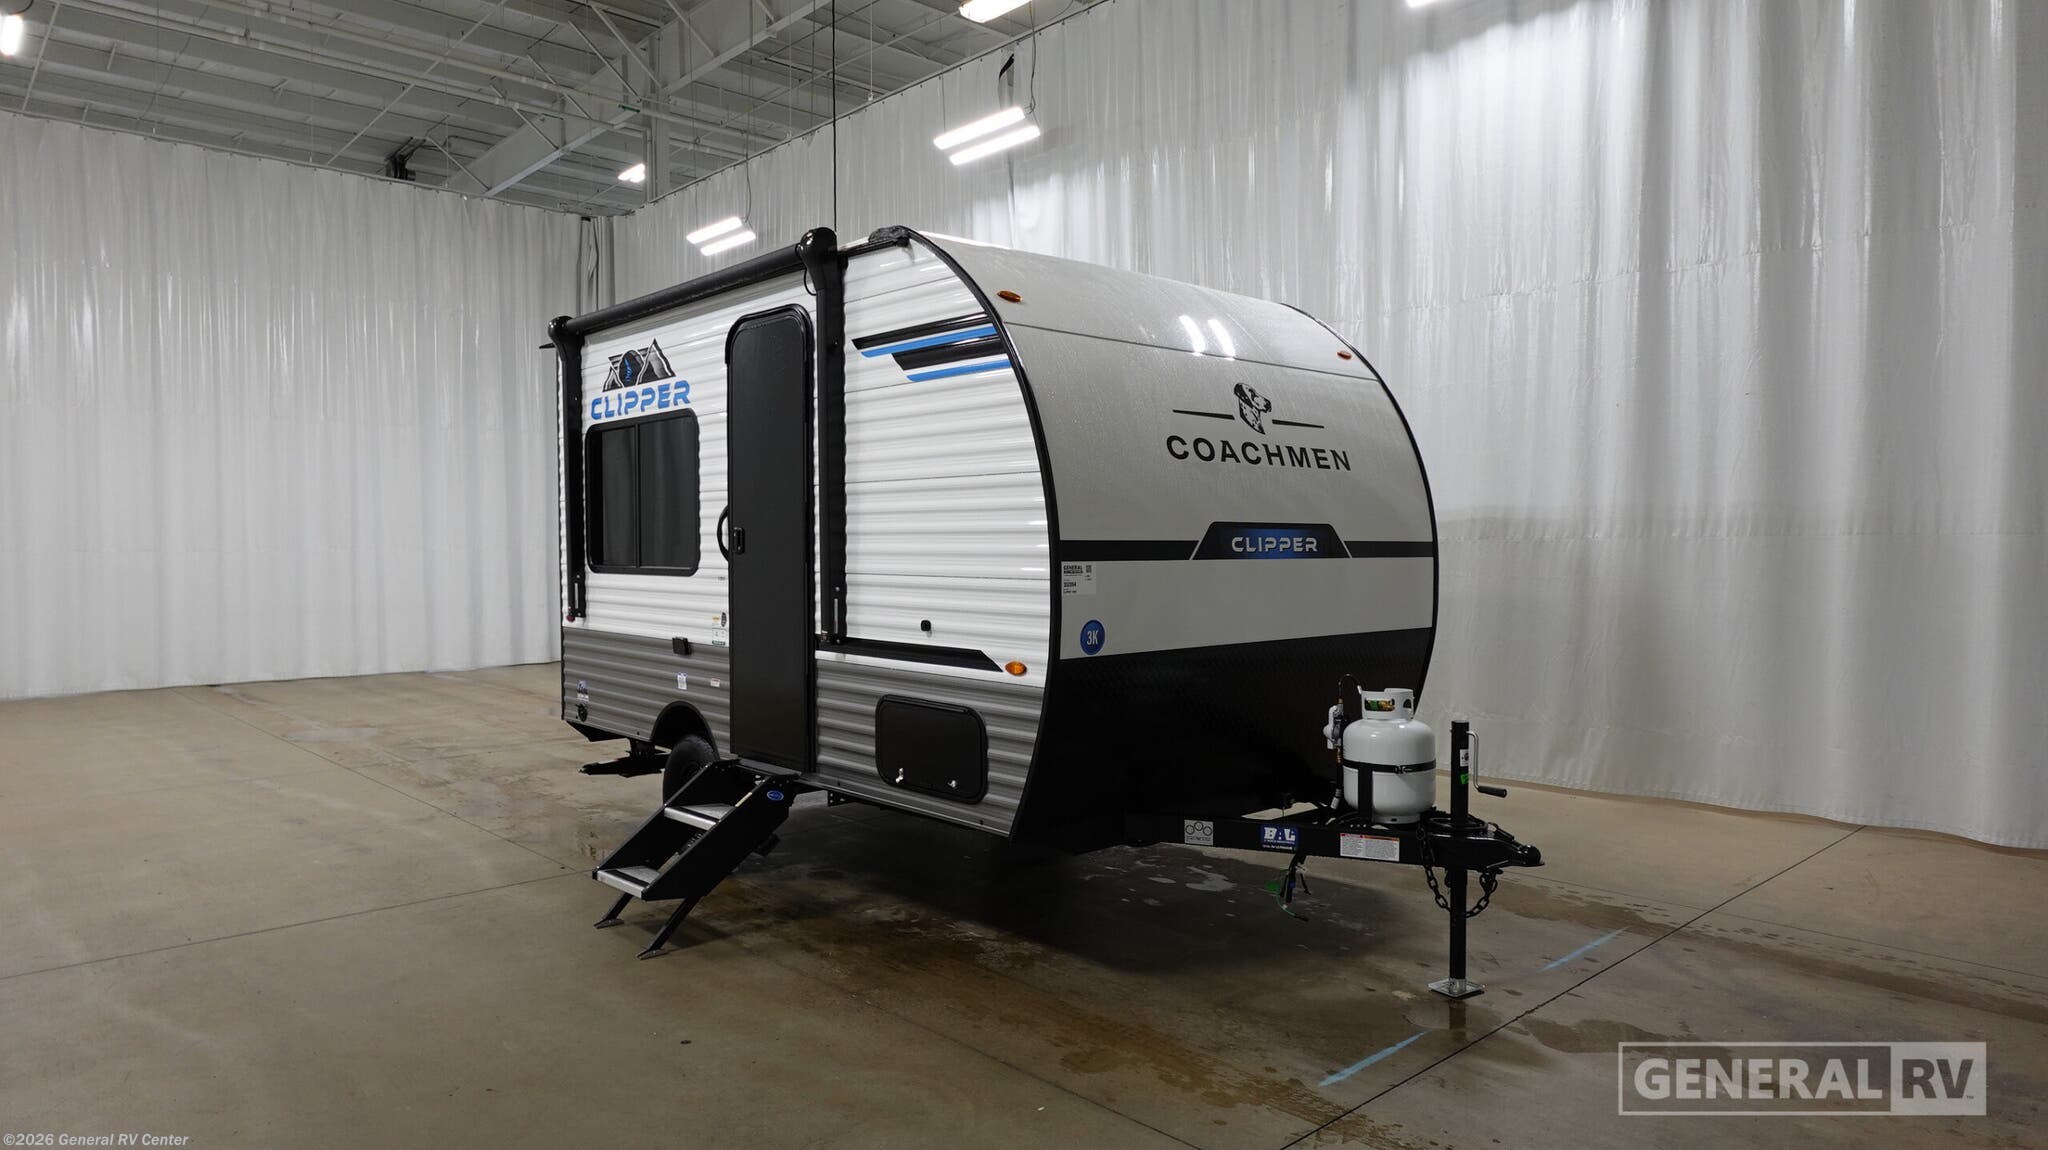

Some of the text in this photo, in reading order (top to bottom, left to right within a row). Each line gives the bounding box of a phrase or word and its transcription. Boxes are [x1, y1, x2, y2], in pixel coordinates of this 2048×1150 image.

[590, 380, 691, 420] CLIPPER
[1166, 435, 1351, 471] COACHMEN
[1231, 536, 1318, 552] CLIPPER
[1086, 630, 1099, 645] 3K
